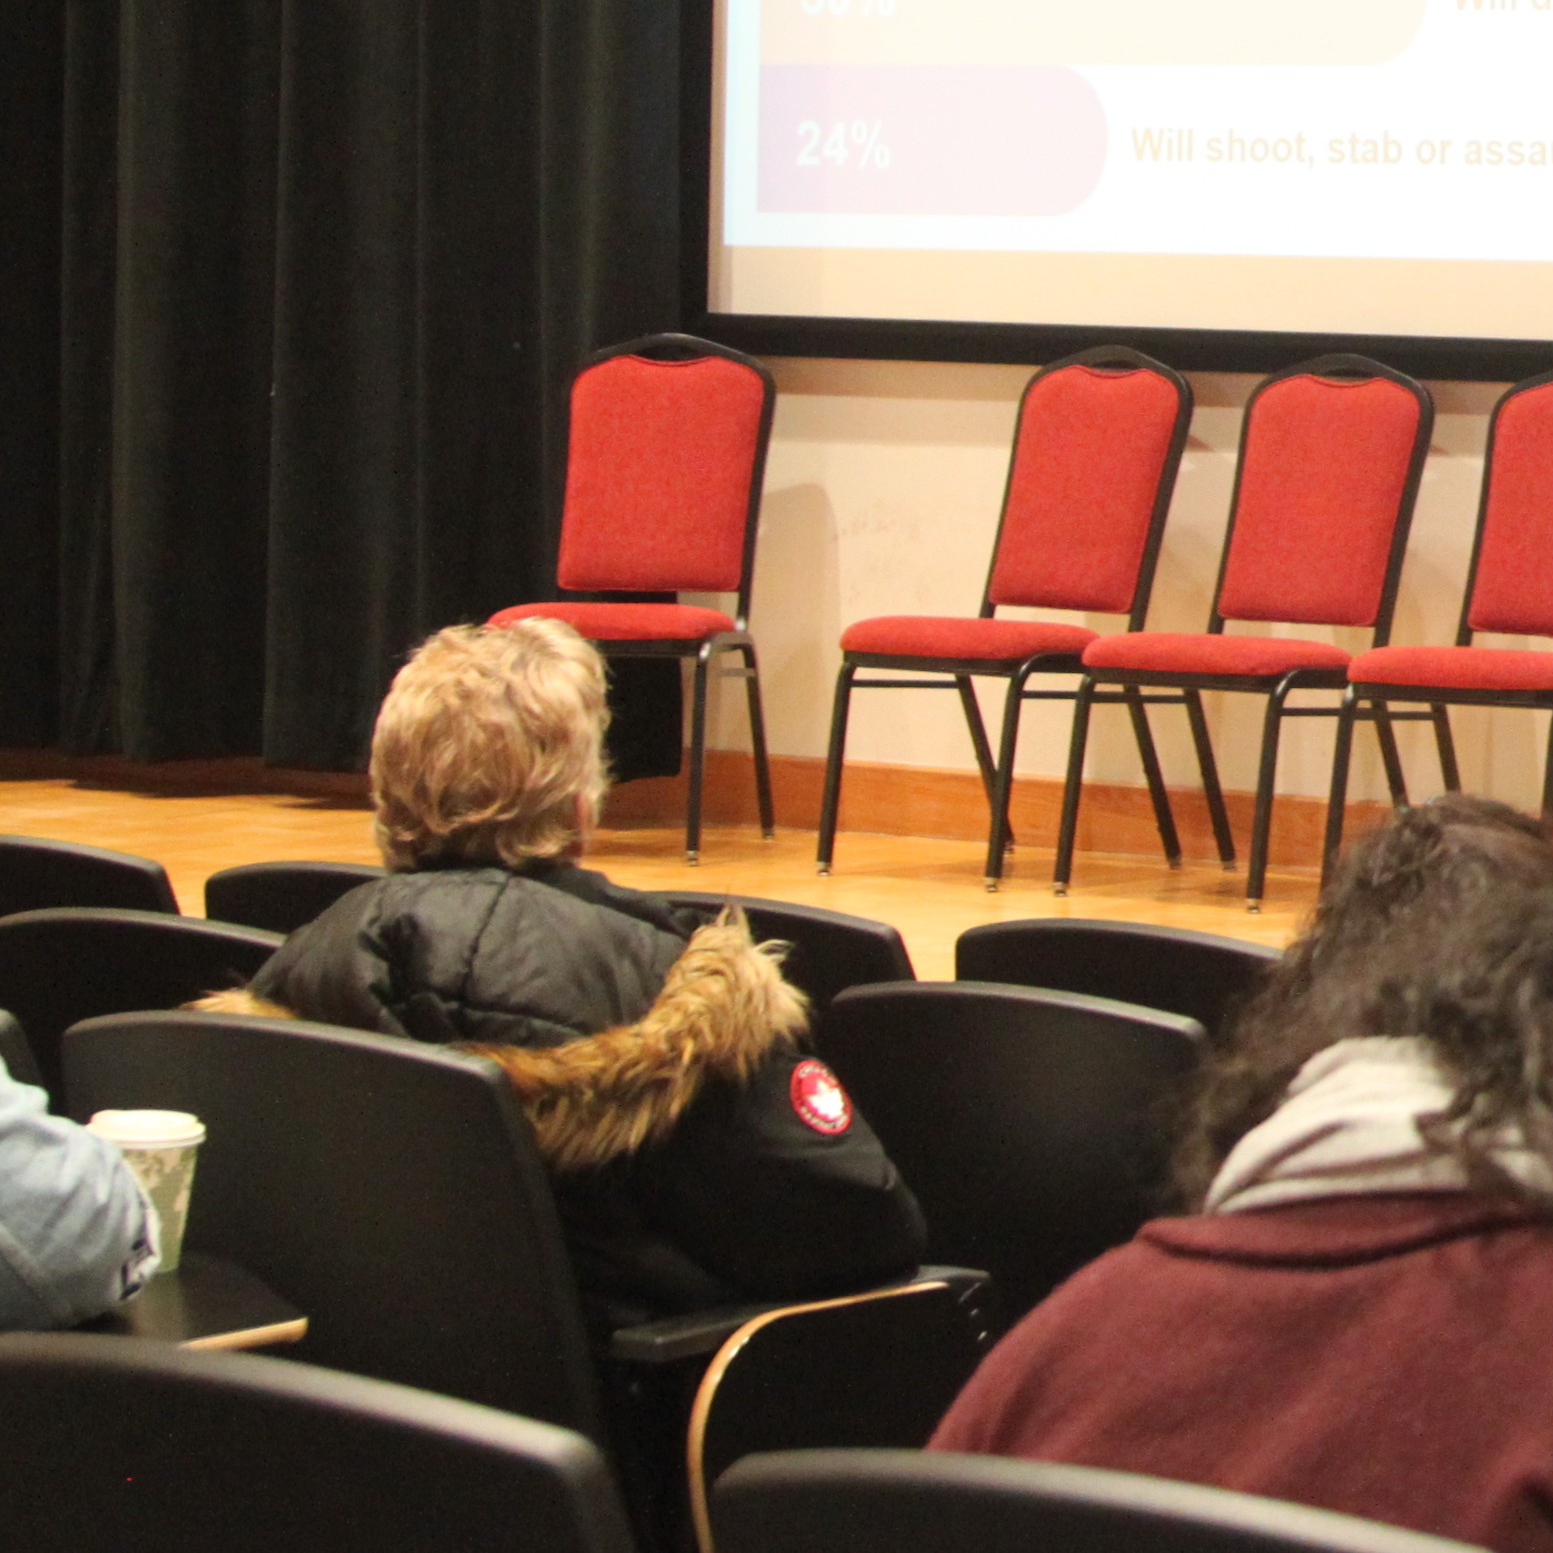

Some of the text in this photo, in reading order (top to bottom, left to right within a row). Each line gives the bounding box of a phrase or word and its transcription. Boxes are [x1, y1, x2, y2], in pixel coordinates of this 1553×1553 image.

[796, 119, 892, 169] 24%
[1131, 127, 1194, 163] Will
[1205, 128, 1315, 169] shoot,
[1327, 131, 1403, 163] stab
[1415, 139, 1453, 165] or
